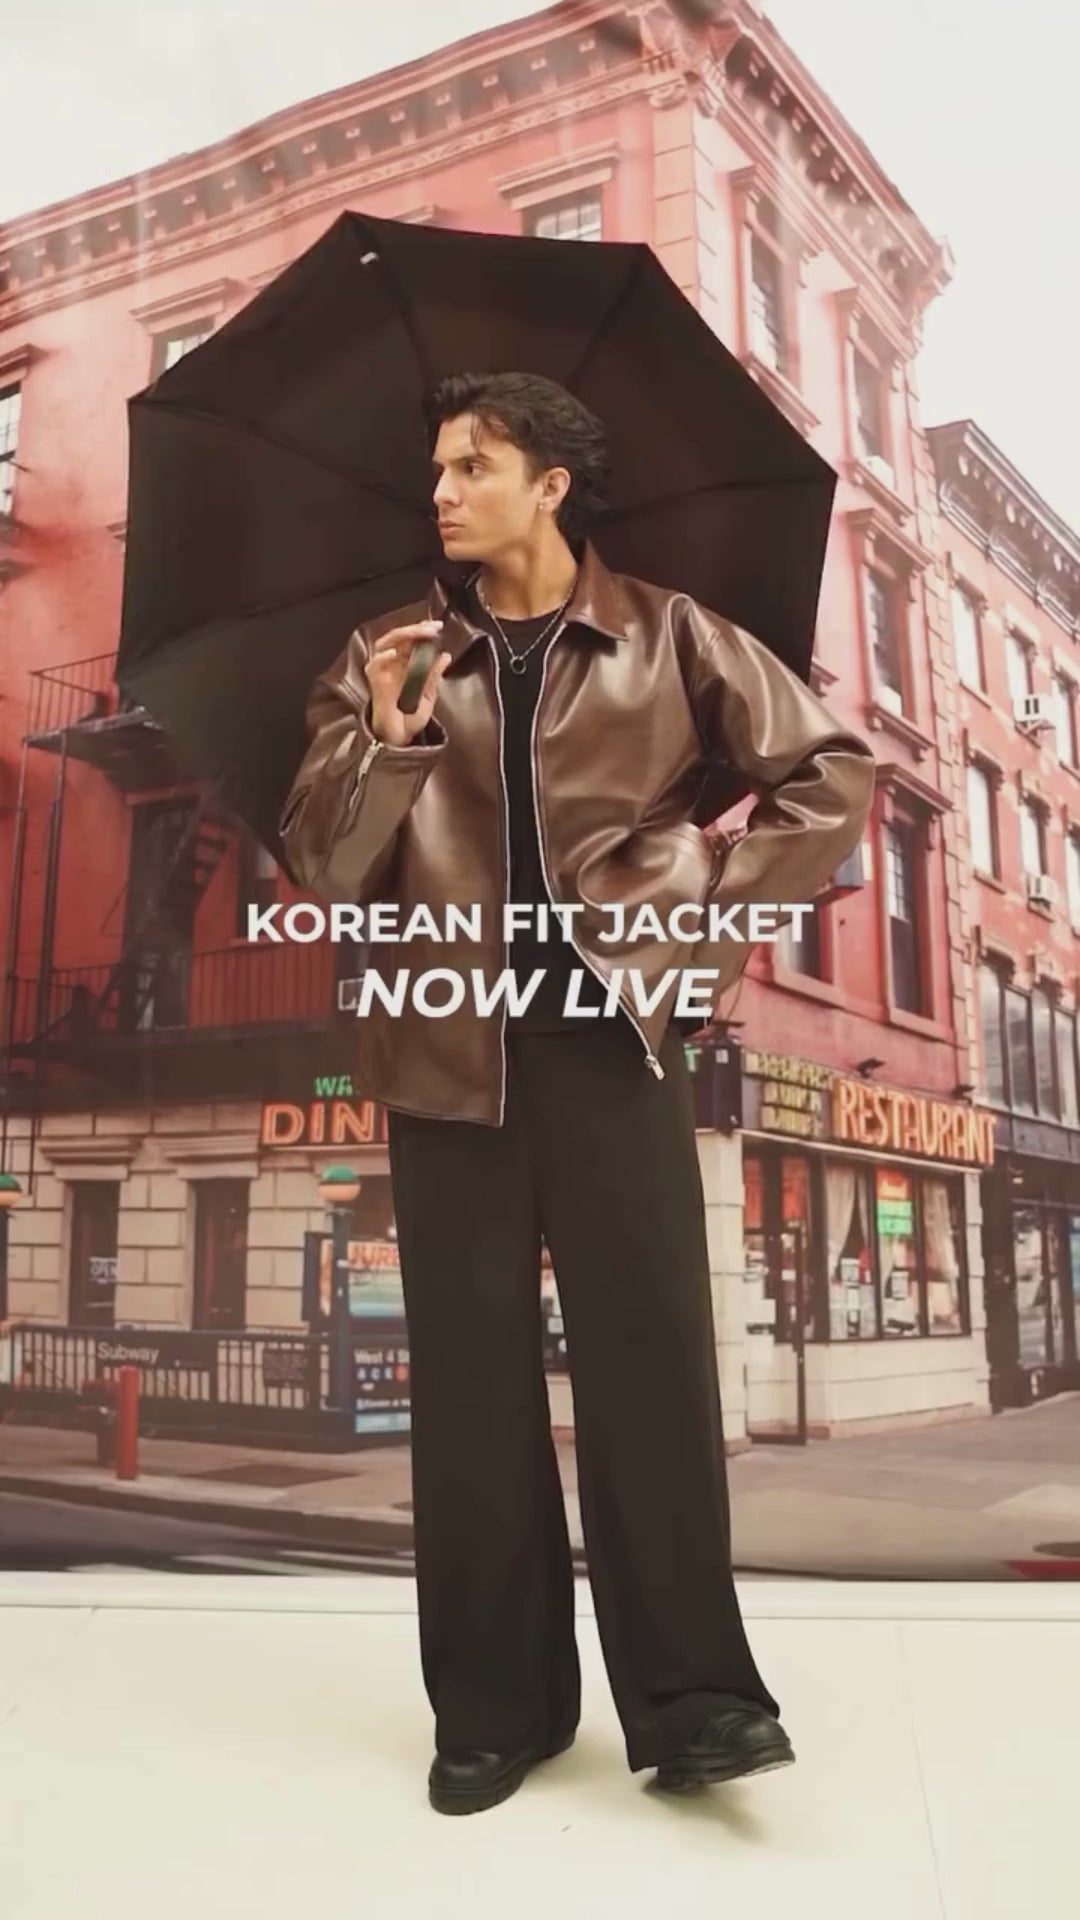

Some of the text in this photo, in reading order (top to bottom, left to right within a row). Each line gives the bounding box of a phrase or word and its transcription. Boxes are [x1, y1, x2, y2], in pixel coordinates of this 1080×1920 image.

[262, 1101, 389, 1145] DIN
[838, 1079, 998, 1166] RESTAURANT
[97, 1341, 160, 1365] Subway
[353, 1349, 384, 1364] West
